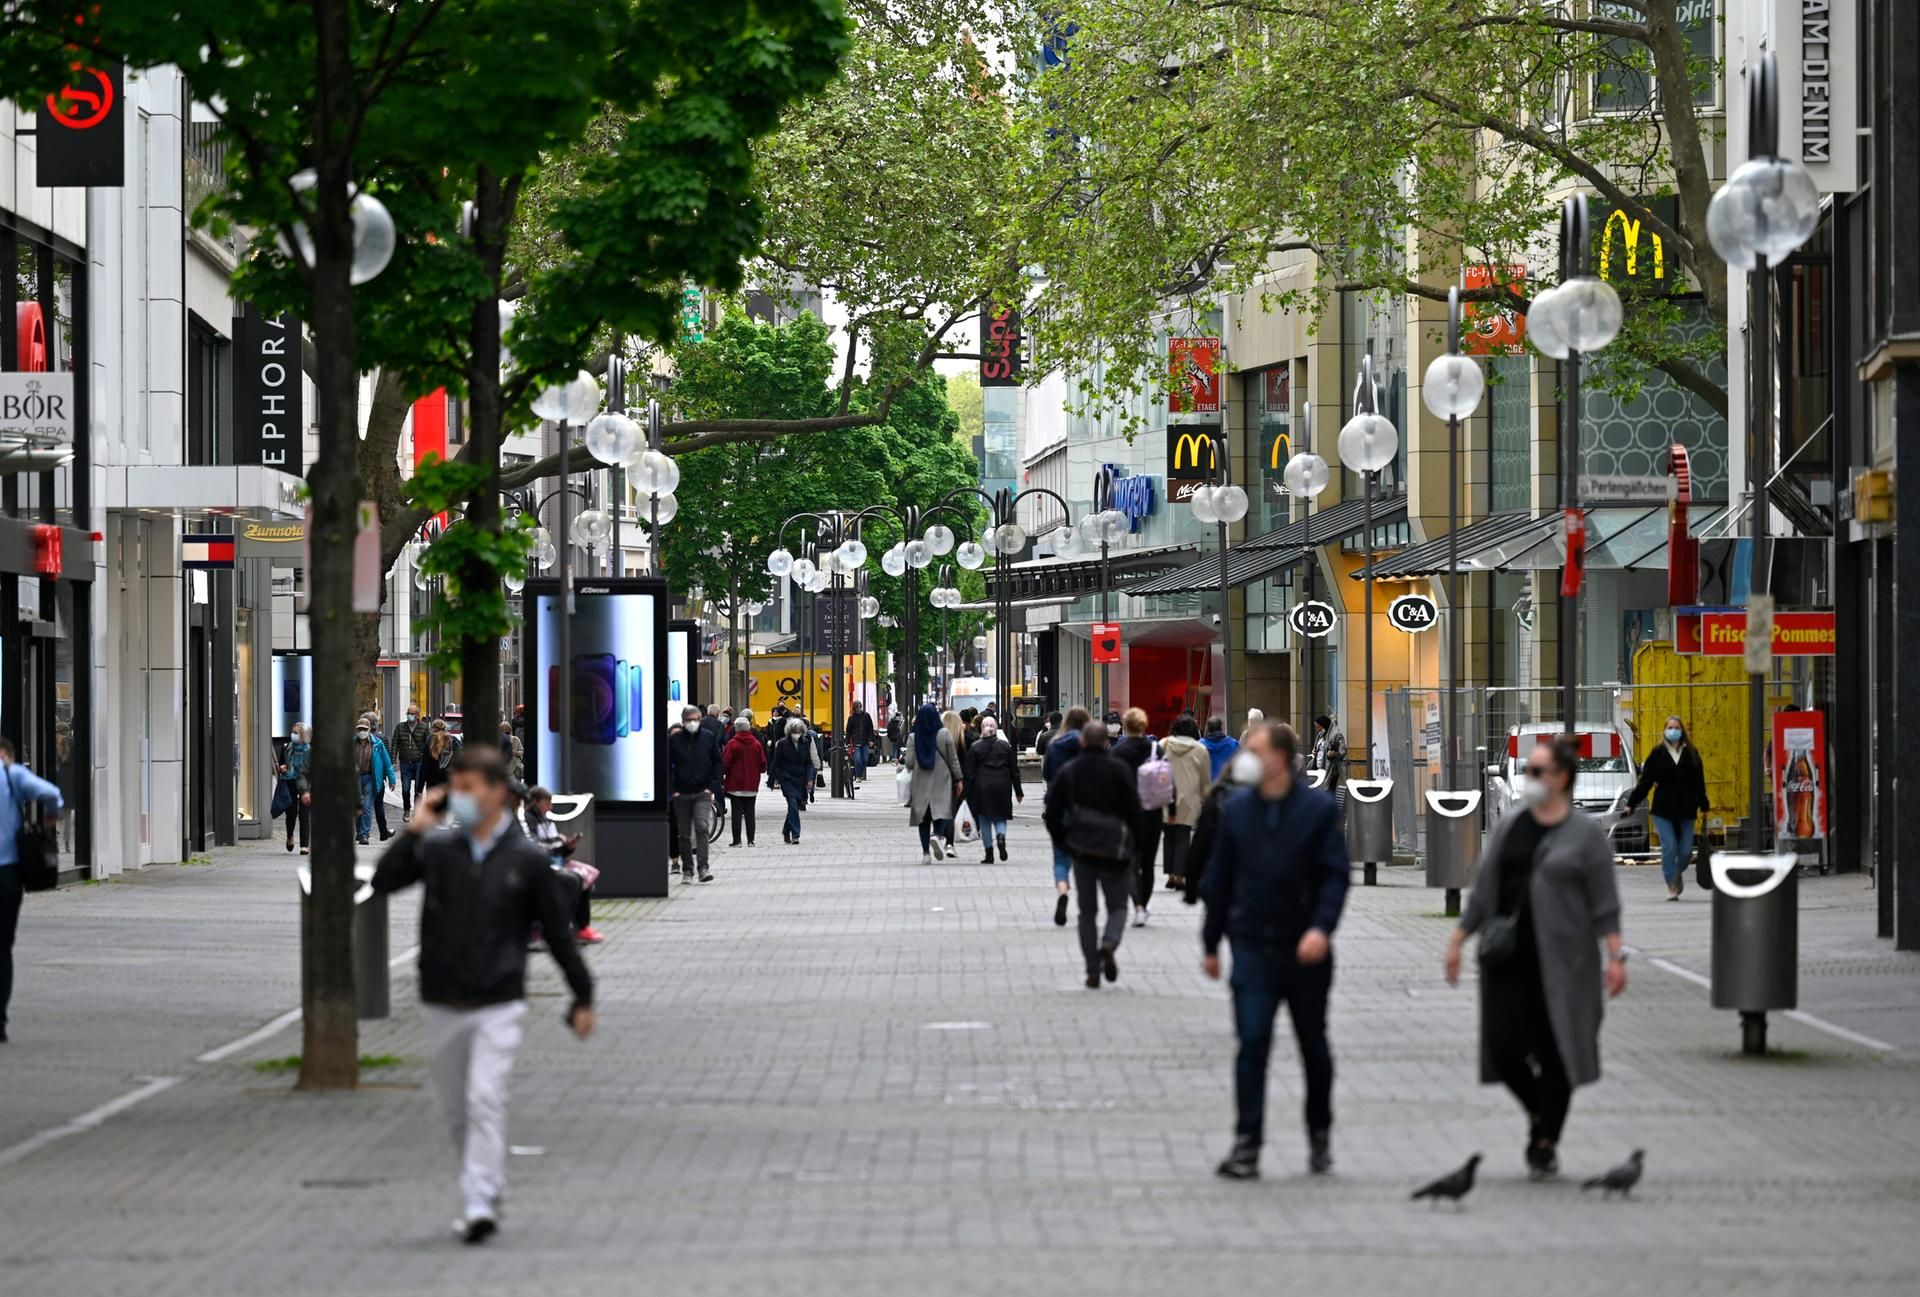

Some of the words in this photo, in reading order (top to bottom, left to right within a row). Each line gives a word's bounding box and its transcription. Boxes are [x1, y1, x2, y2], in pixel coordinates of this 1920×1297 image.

[1803, 0, 1829, 44] AM
[1803, 59, 1829, 162] DENIM
[261, 309, 286, 464] EPHORA
[0, 394, 66, 420] BOR
[1197, 403, 1217, 411] ETAGE
[1176, 482, 1203, 499] McC
[243, 523, 305, 542] Zumnord
[1298, 610, 1330, 628] C&A
[1397, 604, 1431, 622] C&A
[1710, 624, 1747, 643] Frisc
[1771, 624, 1836, 643] Pommes
